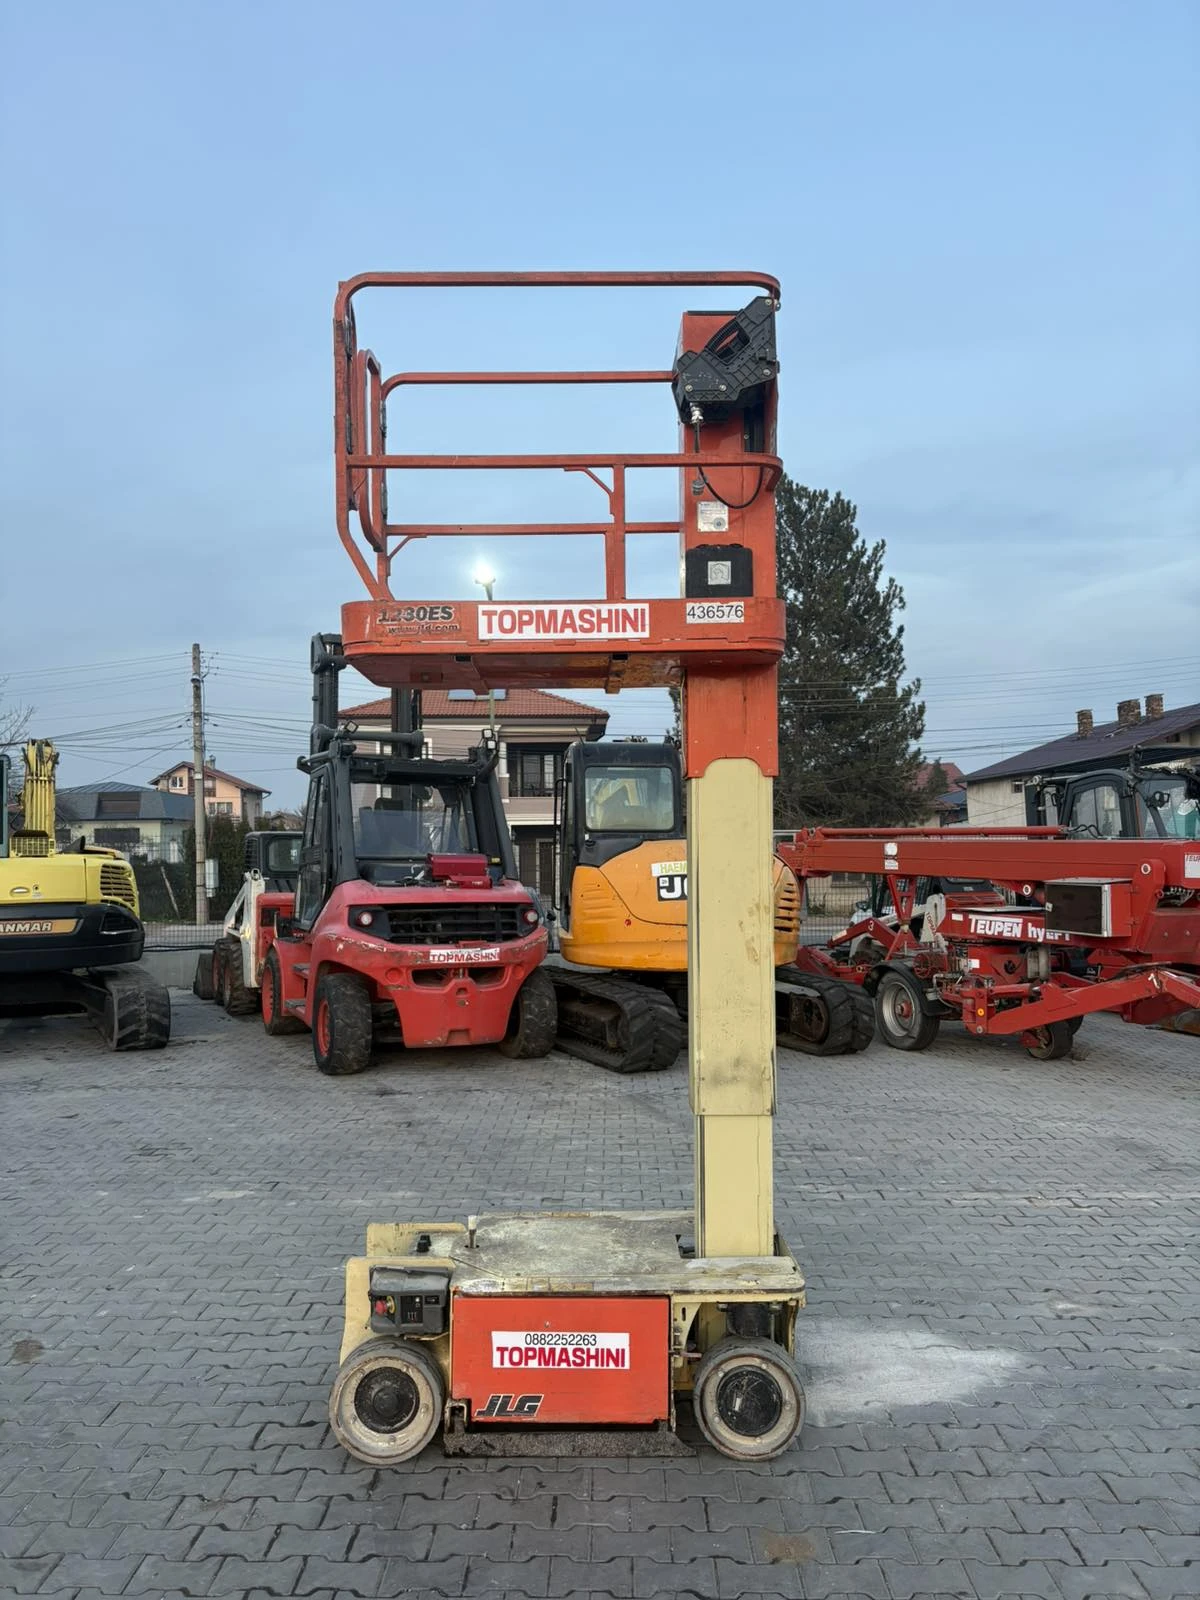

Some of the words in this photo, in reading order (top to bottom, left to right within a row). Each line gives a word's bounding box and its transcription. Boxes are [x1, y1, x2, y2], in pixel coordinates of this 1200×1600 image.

[482, 608, 646, 634] TOPMASHINI
[687, 605, 744, 619] 436576
[969, 914, 1023, 937] TEUPEN
[525, 1333, 597, 1346] 0882252263
[496, 1346, 626, 1368] TOPMASHINI
[474, 1394, 544, 1417] JLG
